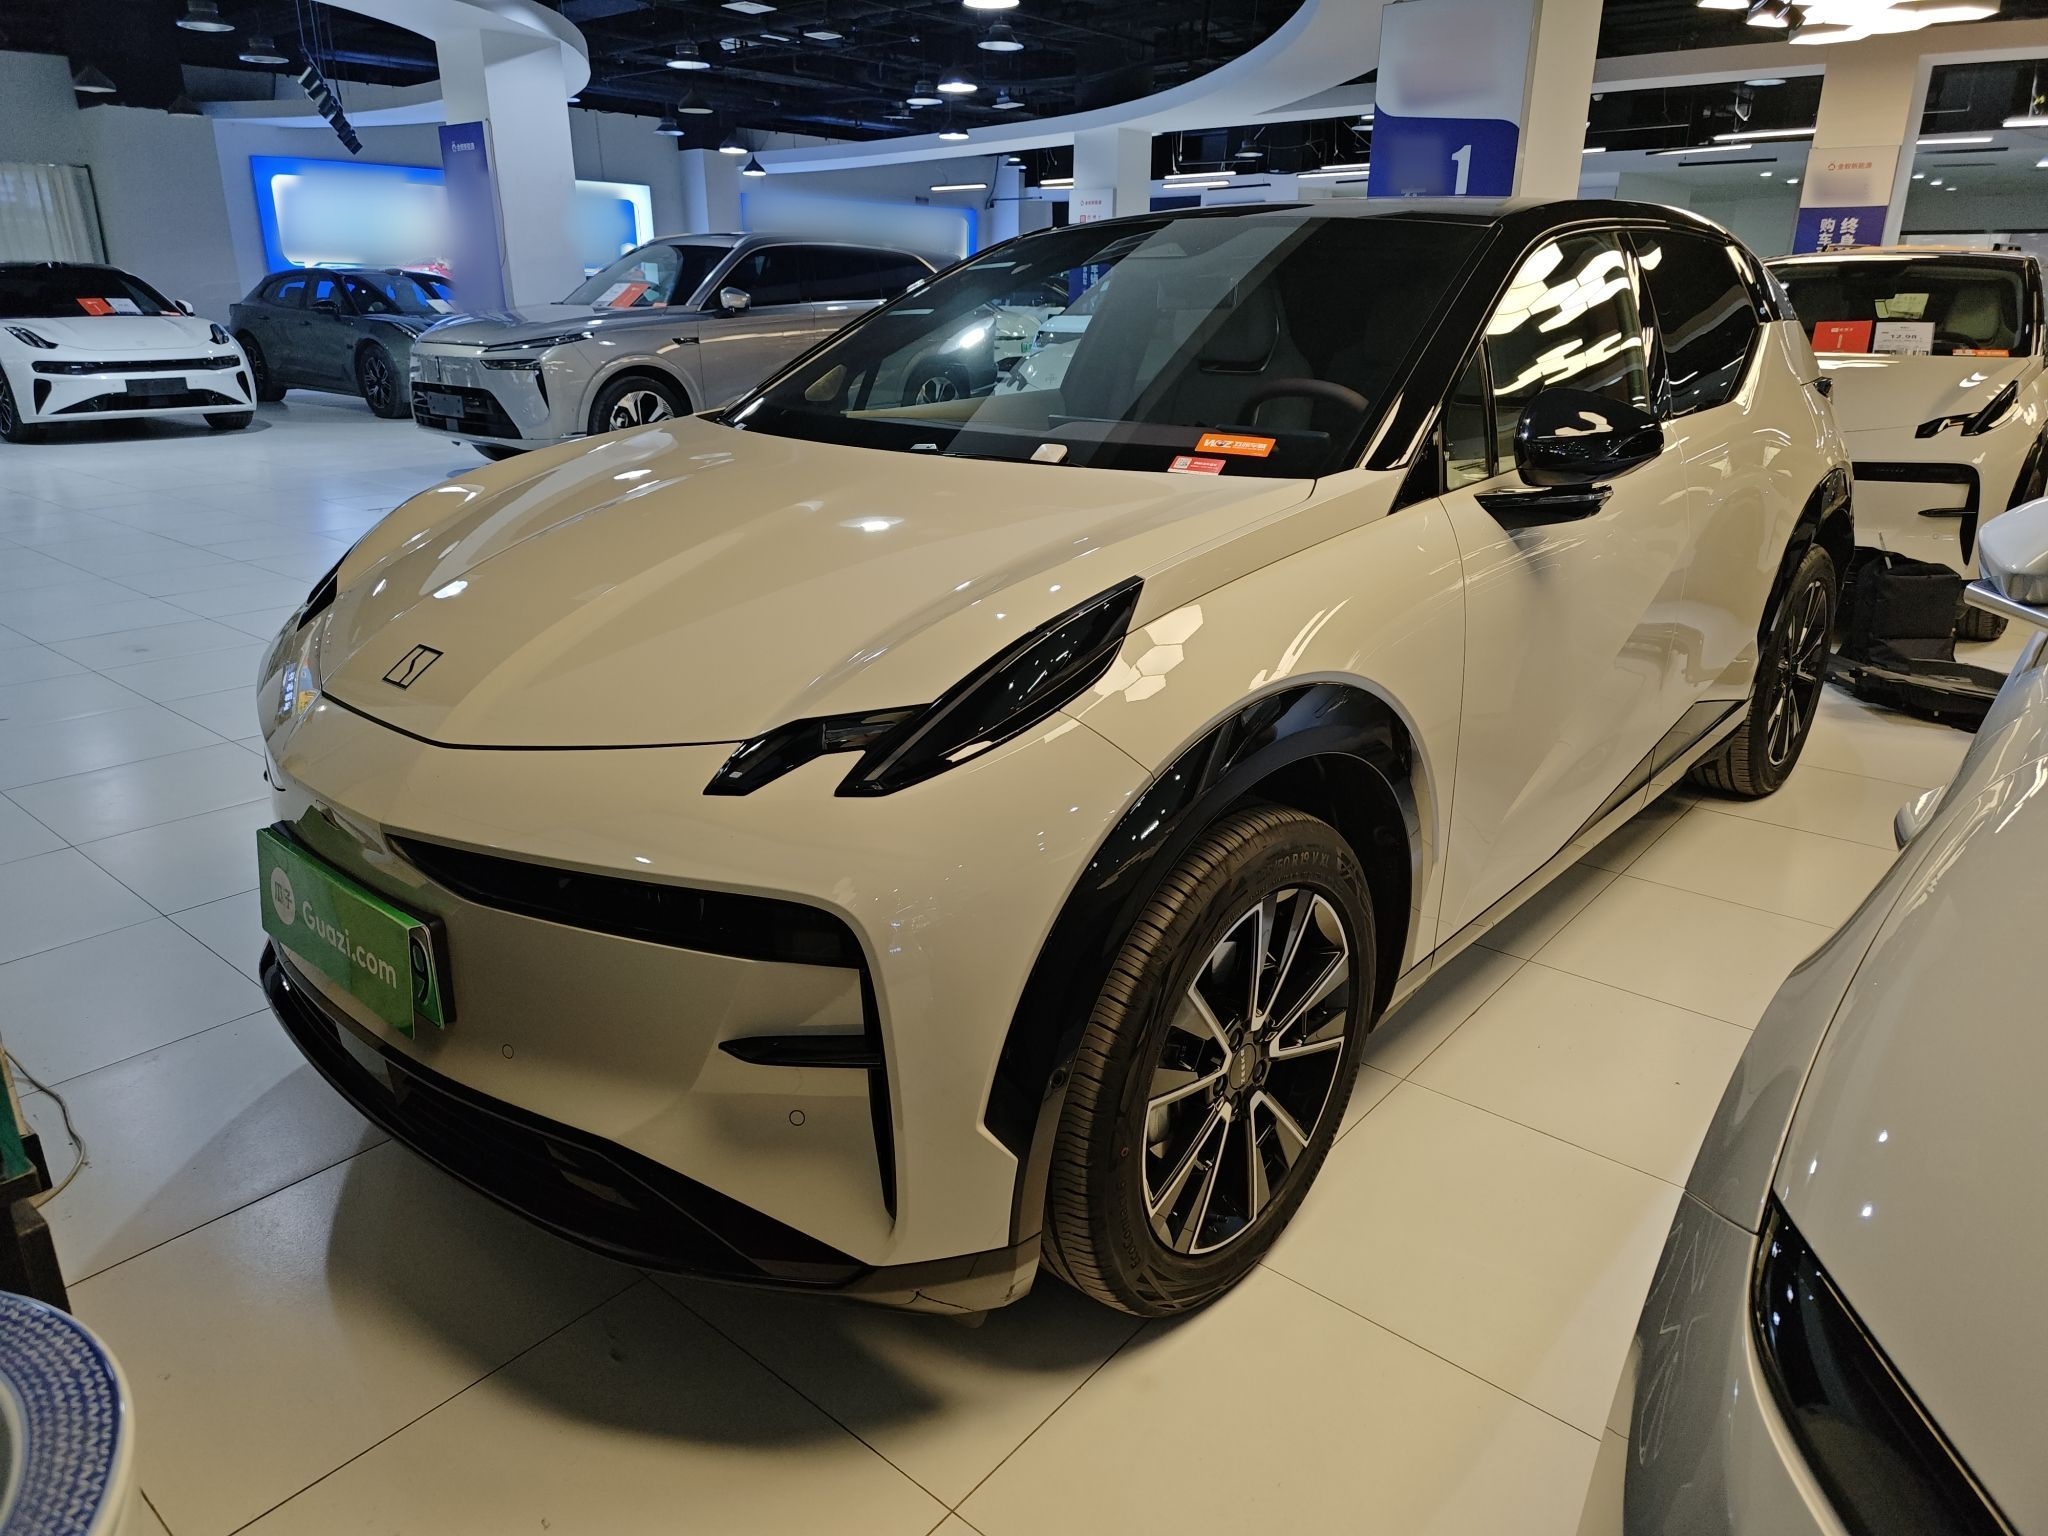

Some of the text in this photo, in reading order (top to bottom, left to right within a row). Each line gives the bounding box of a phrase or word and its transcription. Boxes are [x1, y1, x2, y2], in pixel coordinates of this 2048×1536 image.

[1451, 144, 1472, 195] 1
[1815, 217, 1836, 253] 购车
[274, 881, 293, 910] 瓜子
[302, 900, 397, 989] Guazi.com
